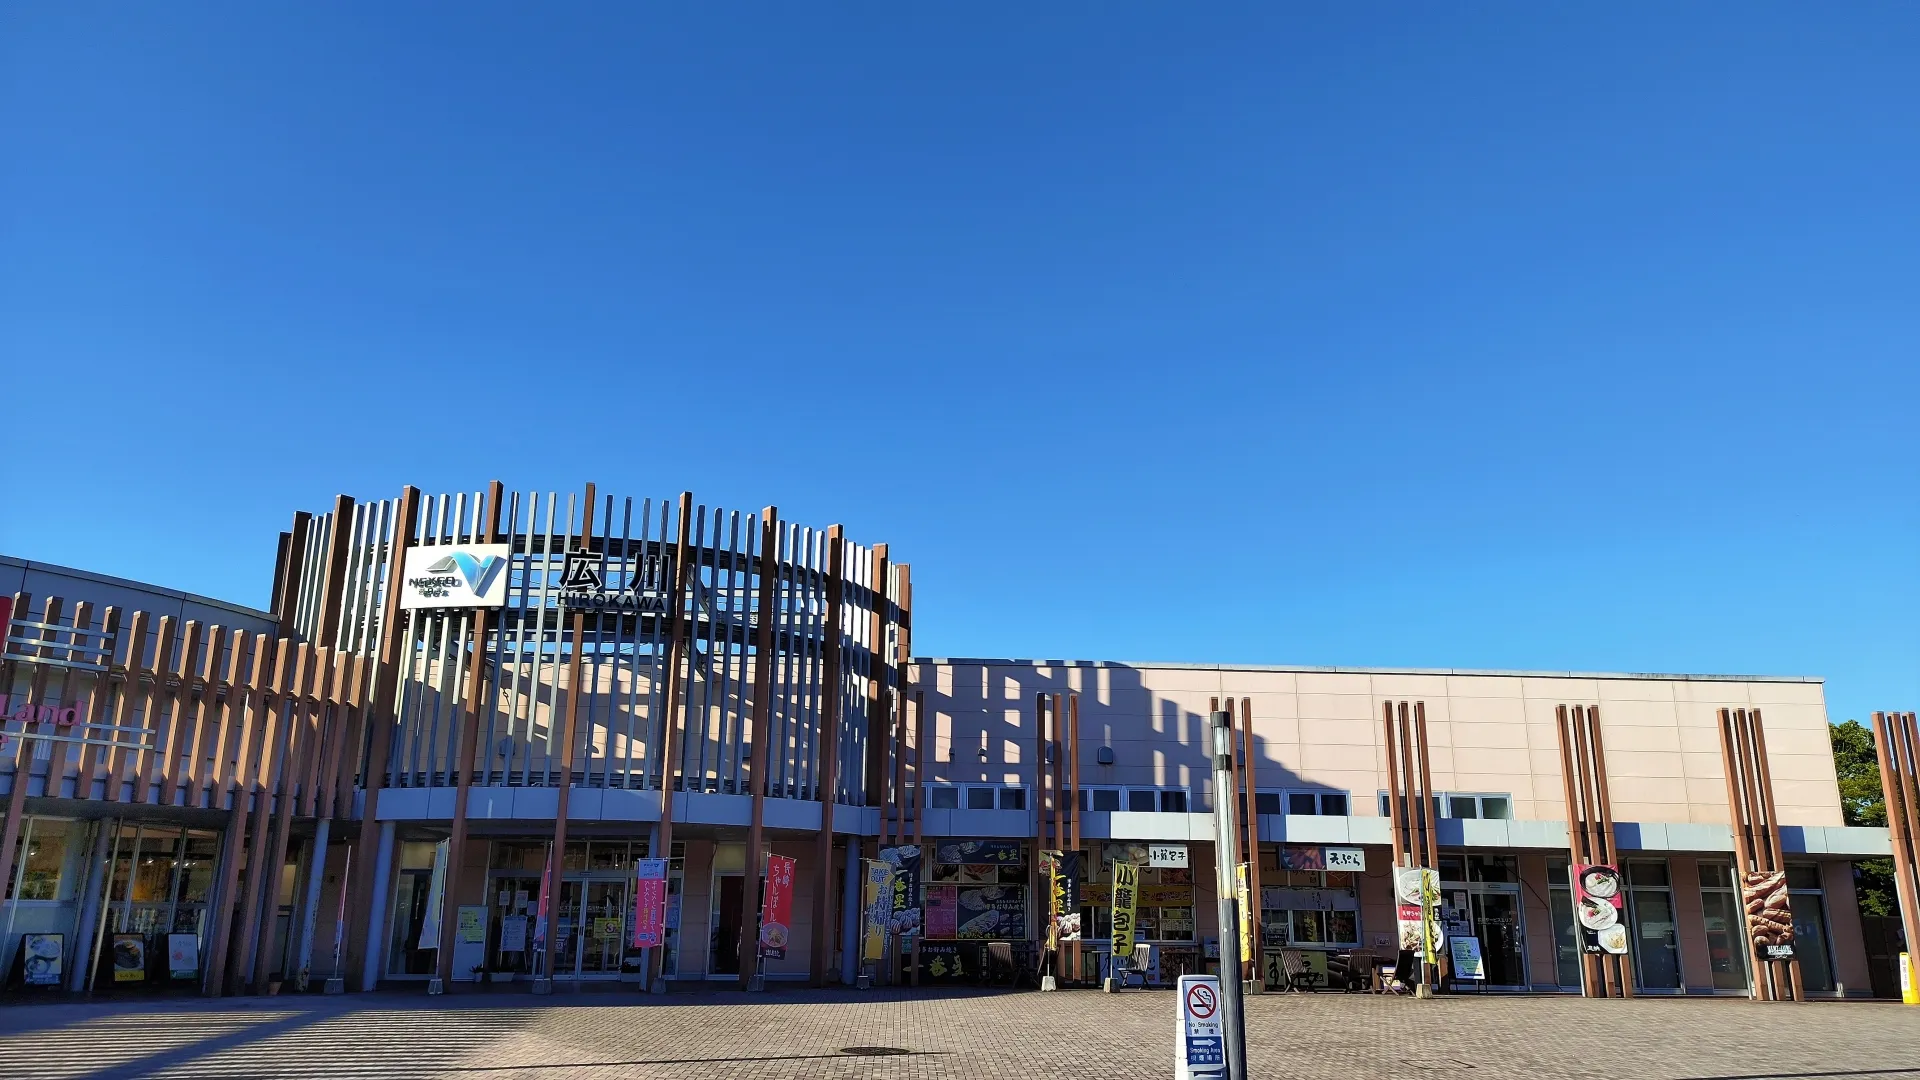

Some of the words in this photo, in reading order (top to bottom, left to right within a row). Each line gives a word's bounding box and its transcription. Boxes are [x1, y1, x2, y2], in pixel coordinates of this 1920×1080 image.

[409, 577, 456, 588] NEXCO
[559, 548, 671, 594] 広川
[557, 592, 666, 611] HIROKAWA
[871, 867, 889, 876] TAKE
[1330, 853, 1359, 867] 天ぷら
[783, 861, 792, 888] 長崎
[769, 865, 782, 922] ちゃんぽん
[1113, 865, 1135, 955] 小籠包子
